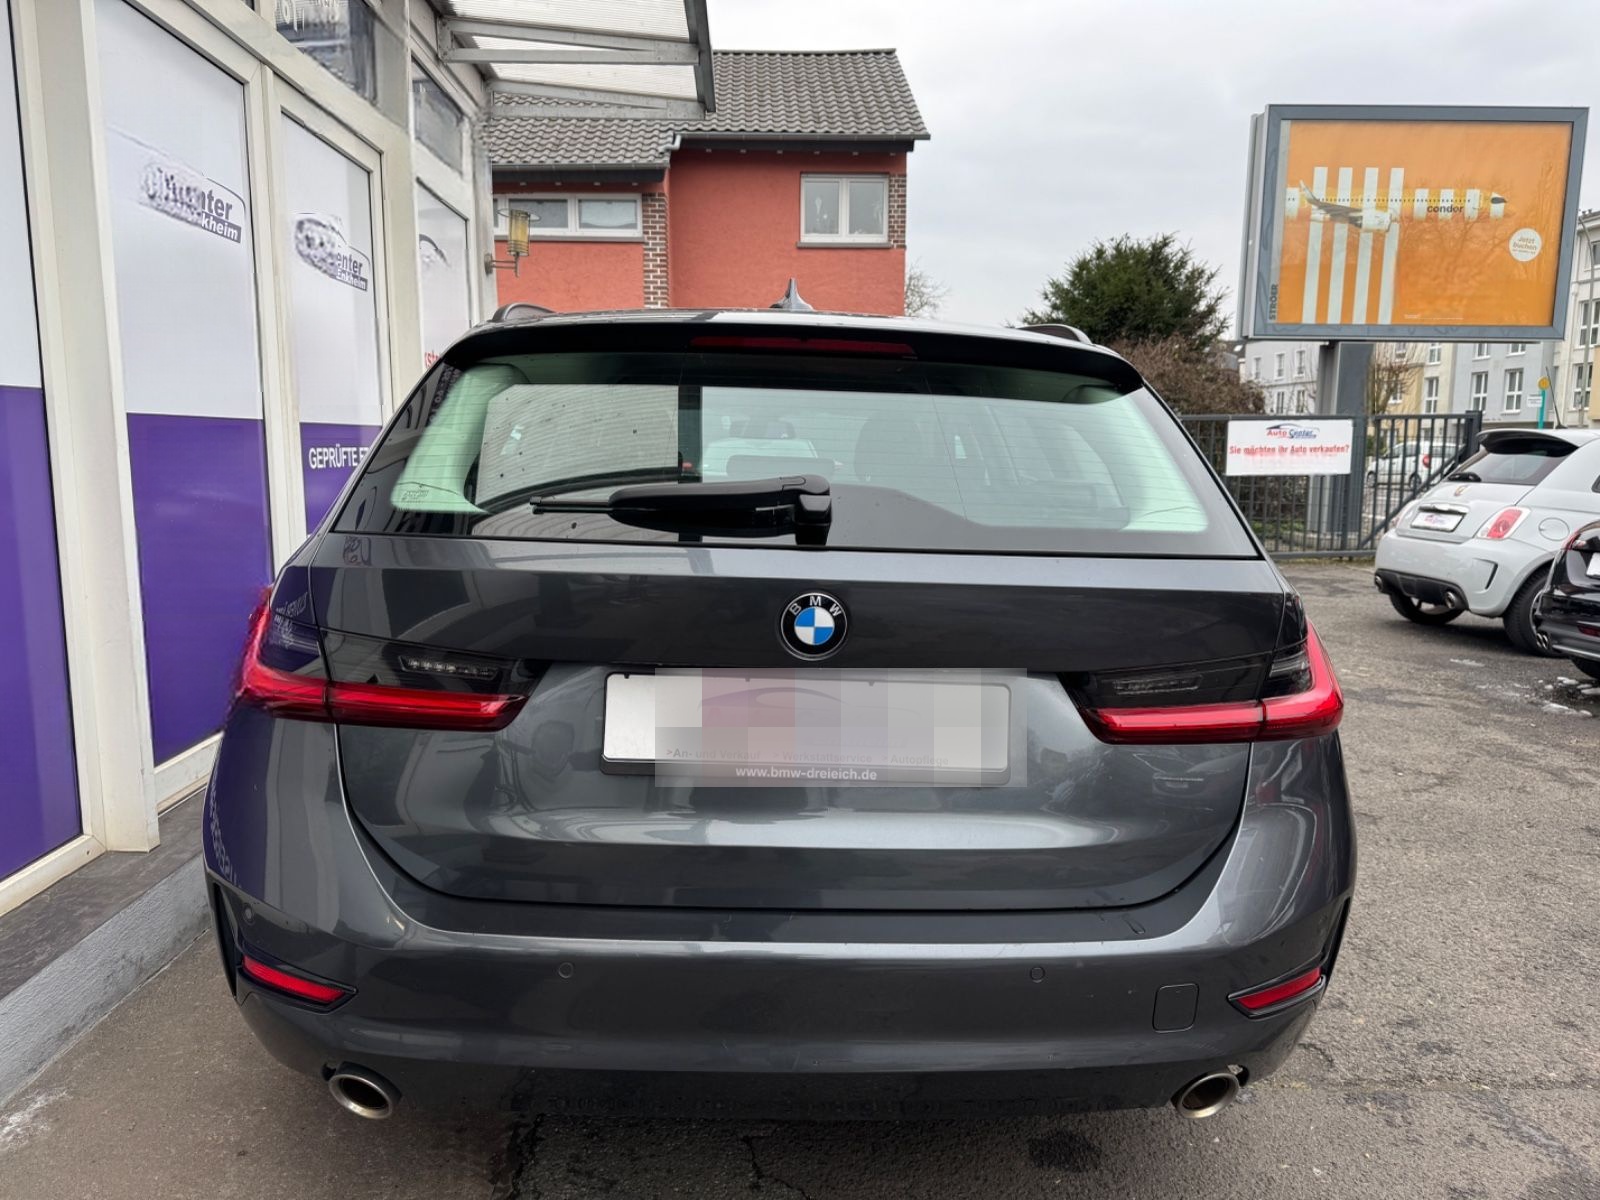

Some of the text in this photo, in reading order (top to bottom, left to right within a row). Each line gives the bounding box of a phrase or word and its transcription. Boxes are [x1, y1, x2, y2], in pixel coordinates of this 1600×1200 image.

[201, 189, 233, 220] nter
[202, 213, 238, 240] kheim
[338, 253, 363, 275] enter
[308, 443, 358, 469] GEPRÜFTE
[1229, 445, 1241, 454] Sie
[789, 595, 842, 617] BMW
[735, 766, 878, 781] www.bmw-dreieich.de
